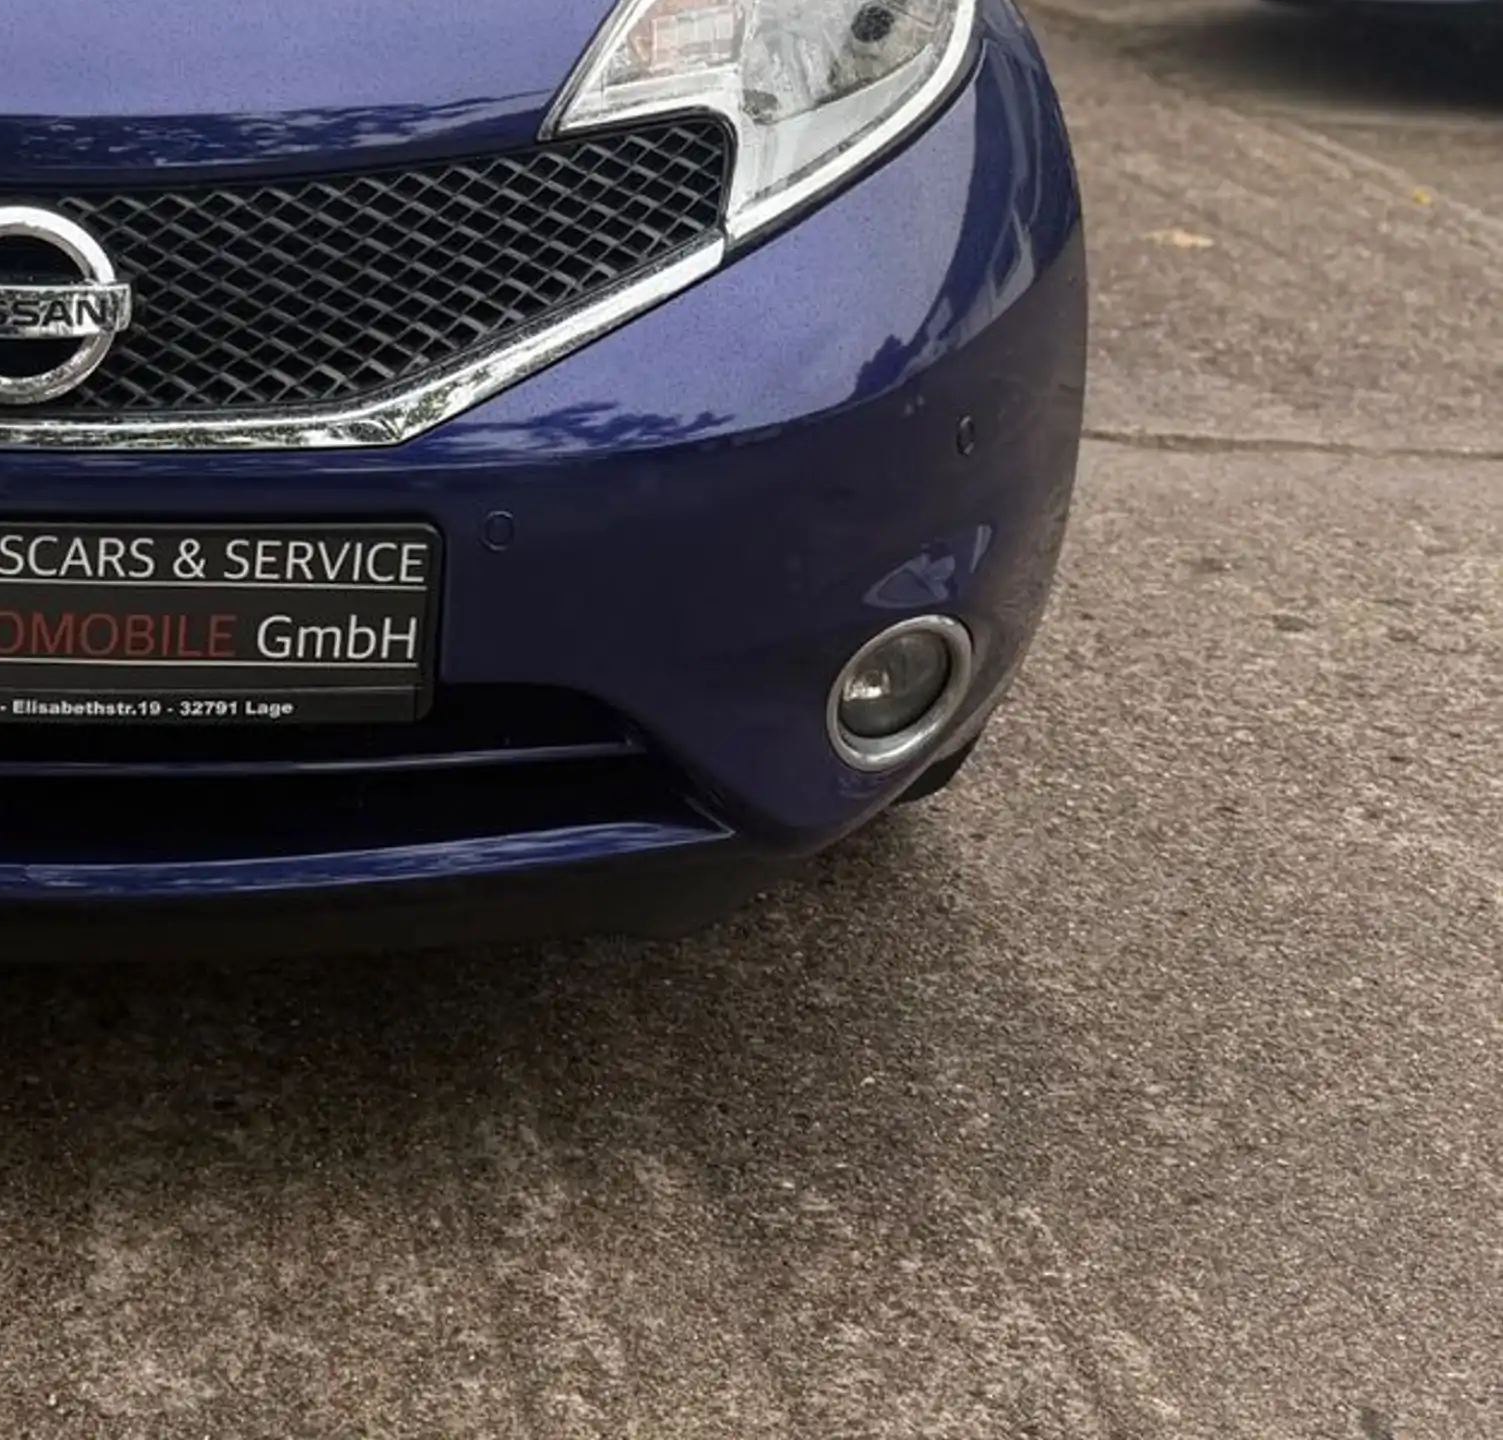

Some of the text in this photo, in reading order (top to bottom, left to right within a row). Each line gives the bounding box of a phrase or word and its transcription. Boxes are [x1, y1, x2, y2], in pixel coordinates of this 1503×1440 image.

[172, 538, 206, 579] &
[223, 539, 428, 583] SERVICE
[256, 614, 418, 660] GmbH
[12, 699, 161, 716] Elisabethstr.19
[180, 700, 238, 717] 32791
[245, 700, 294, 719] Lage
